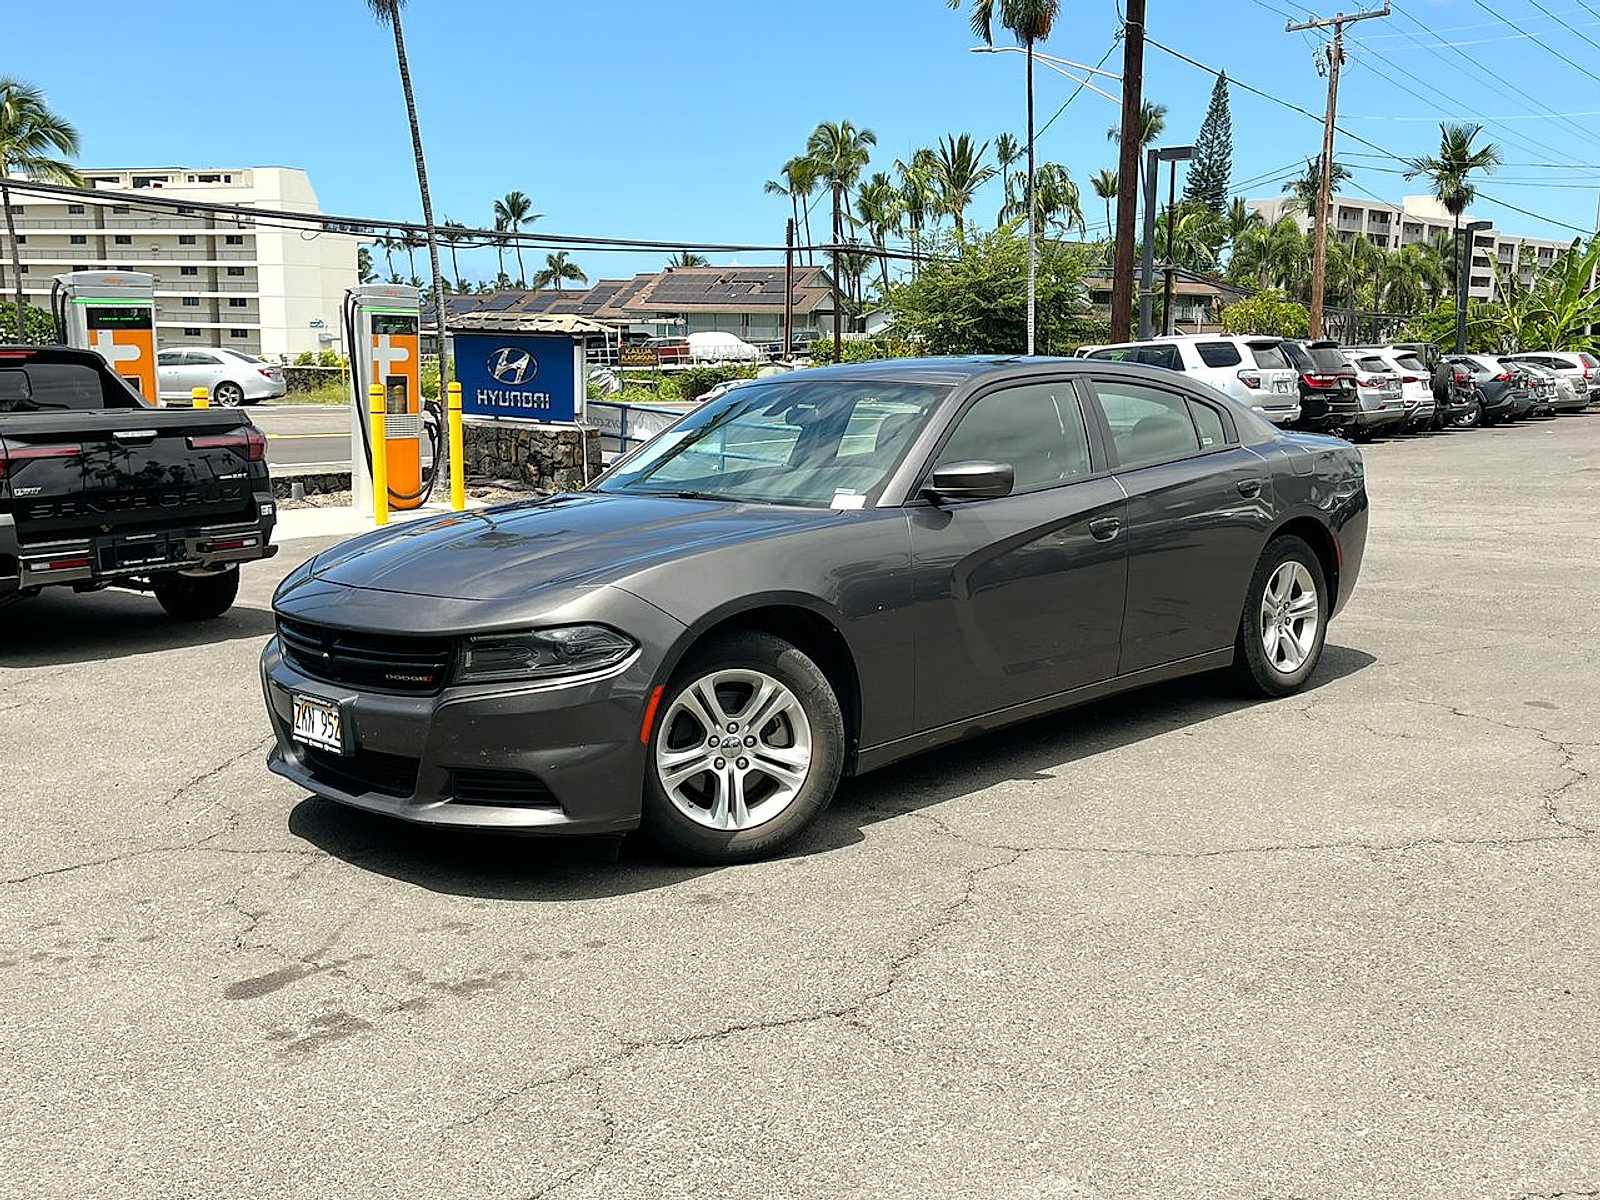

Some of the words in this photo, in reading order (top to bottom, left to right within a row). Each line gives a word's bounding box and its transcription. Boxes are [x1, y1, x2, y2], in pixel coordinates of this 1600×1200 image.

[476, 389, 550, 410] HYUNDAI
[30, 497, 152, 519] SANTA
[160, 486, 242, 507] CRUZ
[385, 674, 428, 682] DODGE
